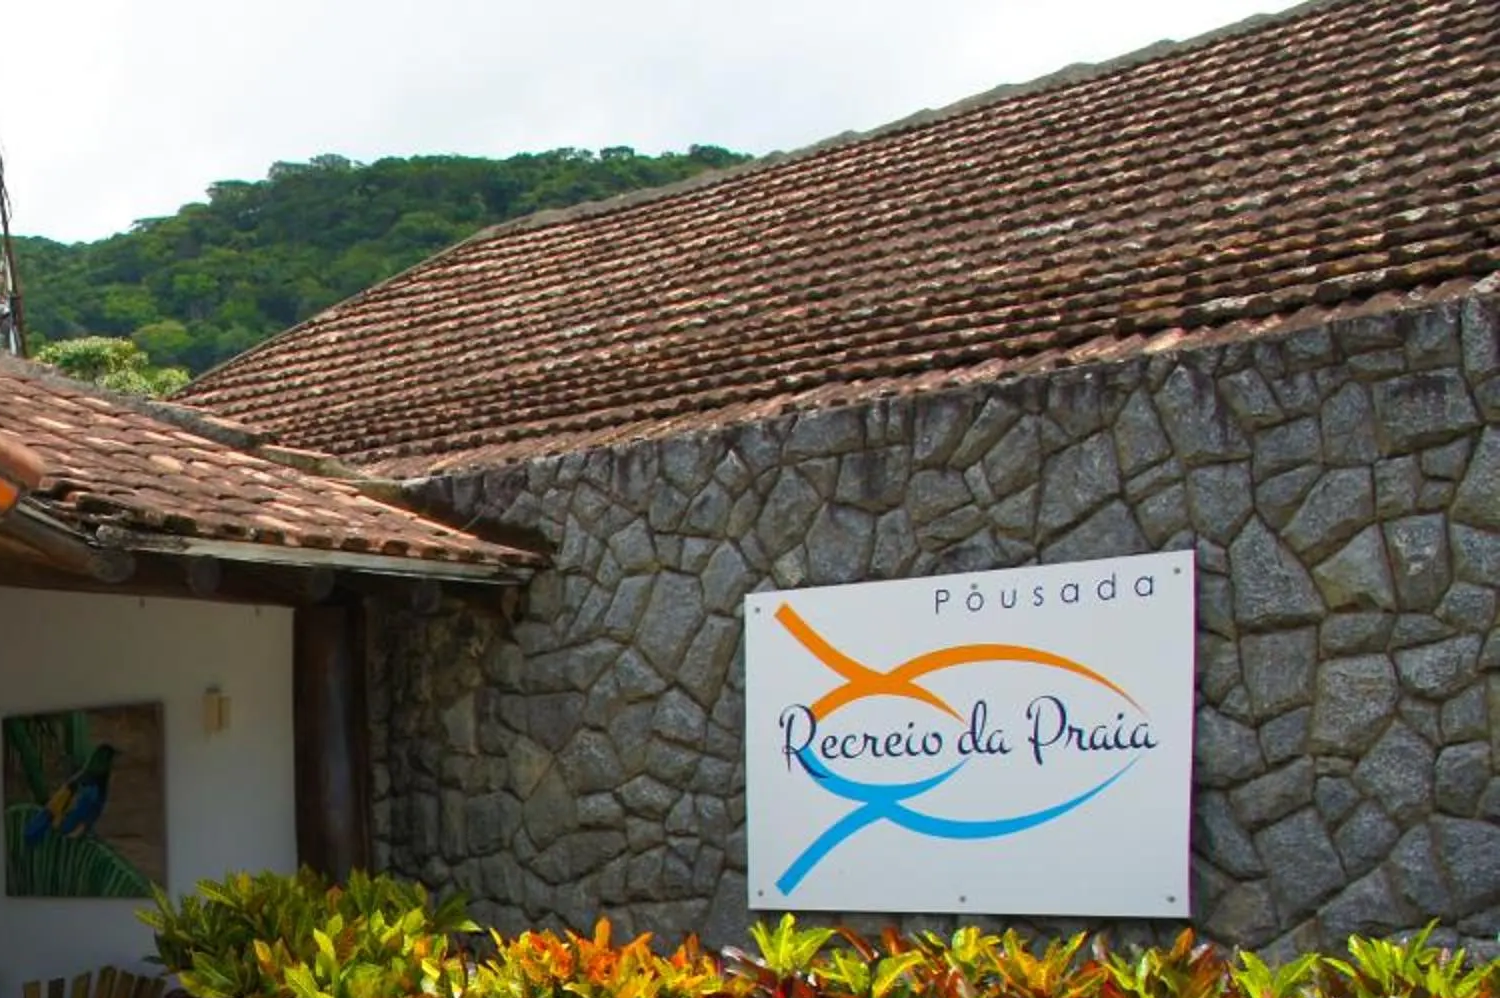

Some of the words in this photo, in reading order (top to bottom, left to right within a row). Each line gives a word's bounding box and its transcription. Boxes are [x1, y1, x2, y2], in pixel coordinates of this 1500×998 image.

[934, 572, 1156, 615] Pousada
[778, 703, 944, 779] Recreio
[957, 699, 1013, 757] da
[1025, 694, 1160, 767] Praia
